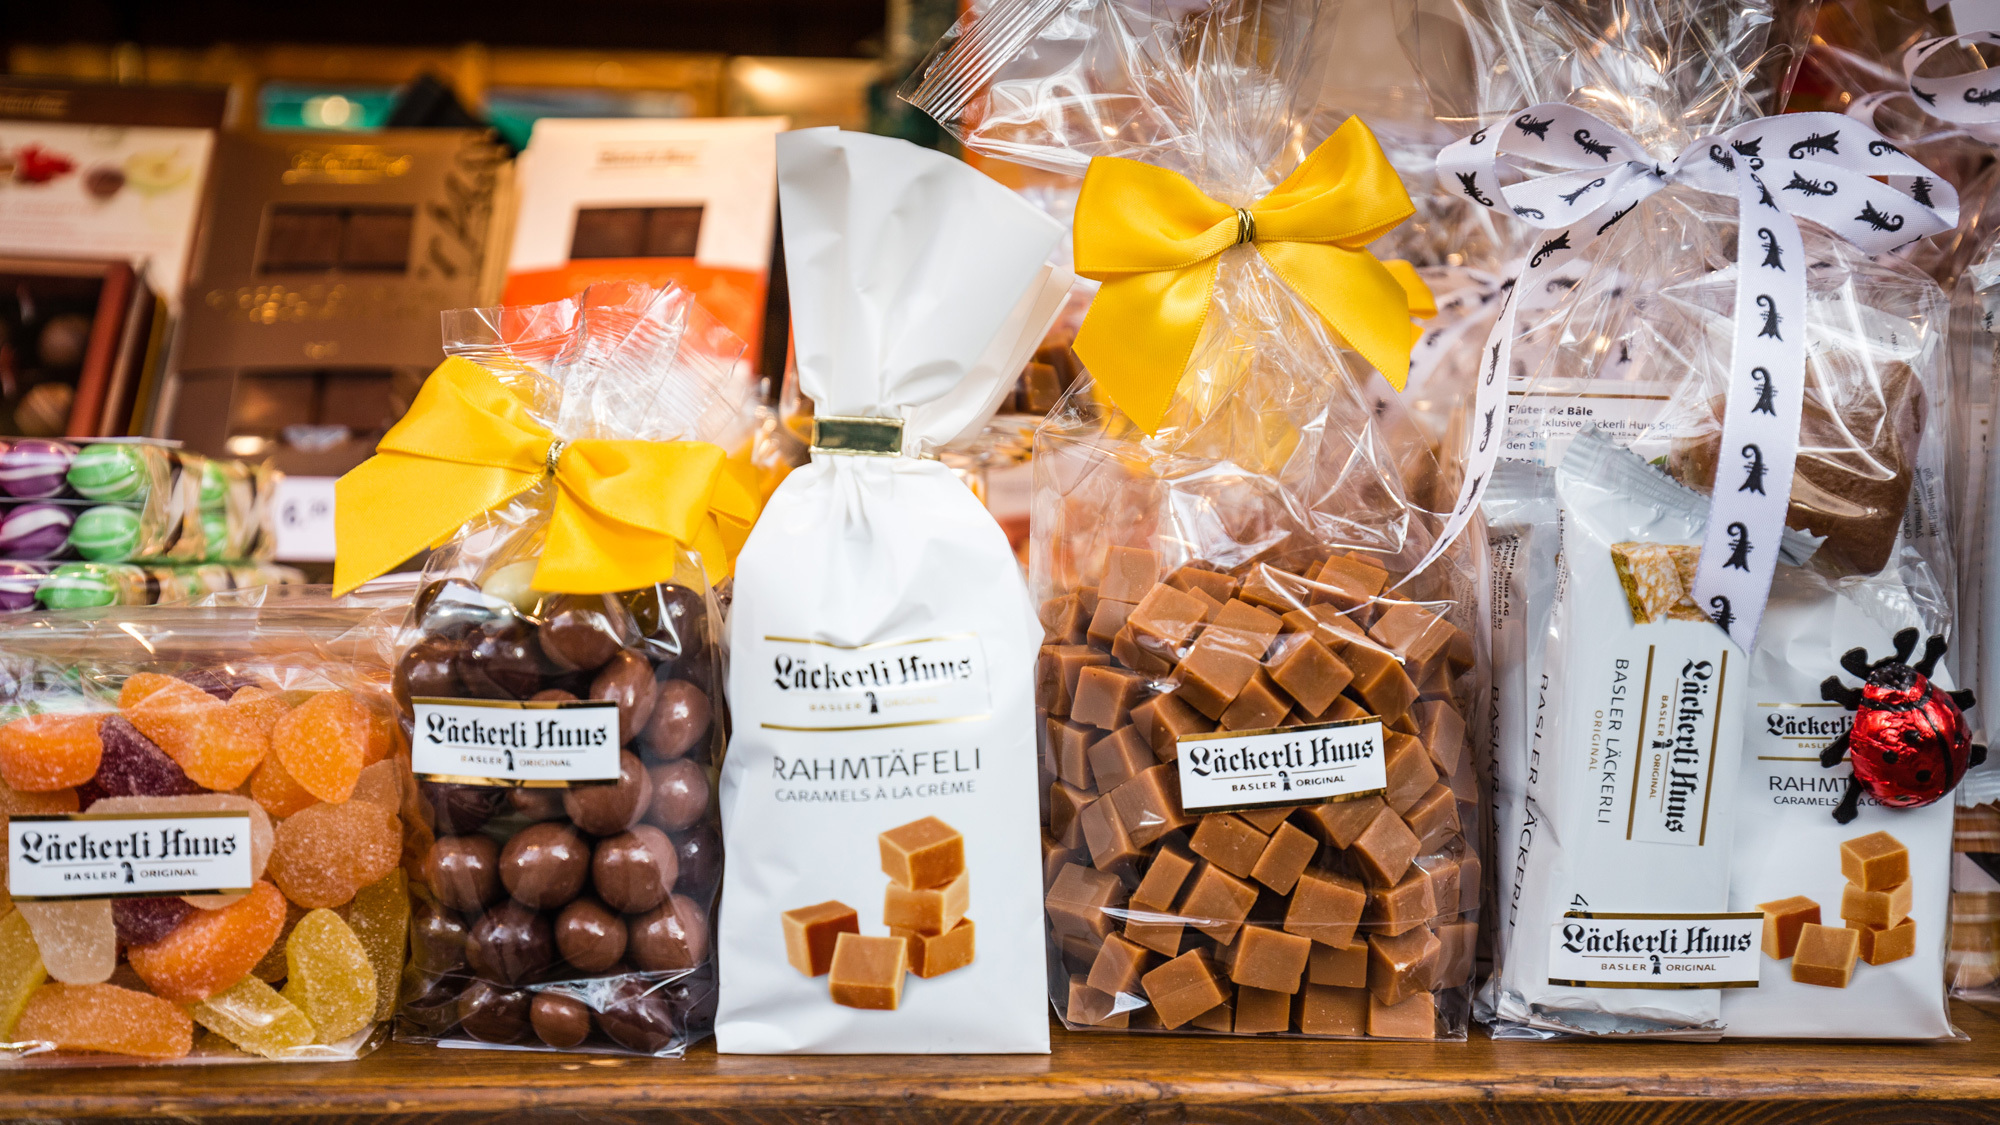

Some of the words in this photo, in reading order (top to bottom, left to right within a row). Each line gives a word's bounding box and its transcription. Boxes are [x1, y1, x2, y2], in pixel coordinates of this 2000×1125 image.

[1533, 417, 1582, 428] eklusive
[1585, 419, 1626, 429] äckerli
[1567, 406, 1593, 416] Bâle
[1506, 441, 1526, 450] den
[1508, 535, 1520, 570] ckerli
[1497, 536, 1512, 616] chsackerstrasse
[1503, 571, 1513, 599] Huus
[1496, 617, 1503, 630] 50
[1502, 601, 1511, 617] AG
[773, 652, 891, 690] Läckerli
[897, 655, 973, 685] Huus
[808, 702, 862, 712] BASLER
[1608, 658, 1630, 731] BASLER
[1673, 658, 1714, 765] Läckerli
[425, 711, 527, 749] Läckerli
[532, 718, 607, 749] Huus
[1527, 673, 1550, 785] BASLER
[1657, 694, 1669, 737] BASLER
[1189, 741, 1303, 777] Läckerli
[1308, 736, 1375, 768] Huus
[1588, 709, 1604, 772] ORIGINAL
[460, 754, 503, 765] BASLER
[519, 758, 572, 768] ORIGINAL
[772, 747, 981, 781] RAHMTÄFELI
[1648, 753, 1662, 800] ORIGINAL
[774, 787, 870, 804] CARAMELS
[874, 783, 890, 800] À
[892, 783, 913, 800] LA
[915, 779, 976, 799] CRÈME
[1231, 781, 1278, 792] BASLER
[1296, 775, 1347, 787] ORIGINAL
[1597, 738, 1622, 825] LÄCKERLI
[1664, 766, 1700, 833] Huus
[1773, 795, 1839, 807] CARAMELS
[19, 829, 152, 864] Läckerli
[158, 827, 237, 859] Huus
[1508, 795, 1539, 928] LÄCKERLI
[63, 869, 118, 882] BASLER
[139, 867, 199, 880] ORIGINAL
[1560, 923, 1678, 955] Läckerli
[1679, 925, 1753, 956] Huus
[1600, 962, 1647, 972] BASLER
[1665, 962, 1718, 973] ORIGINAL
